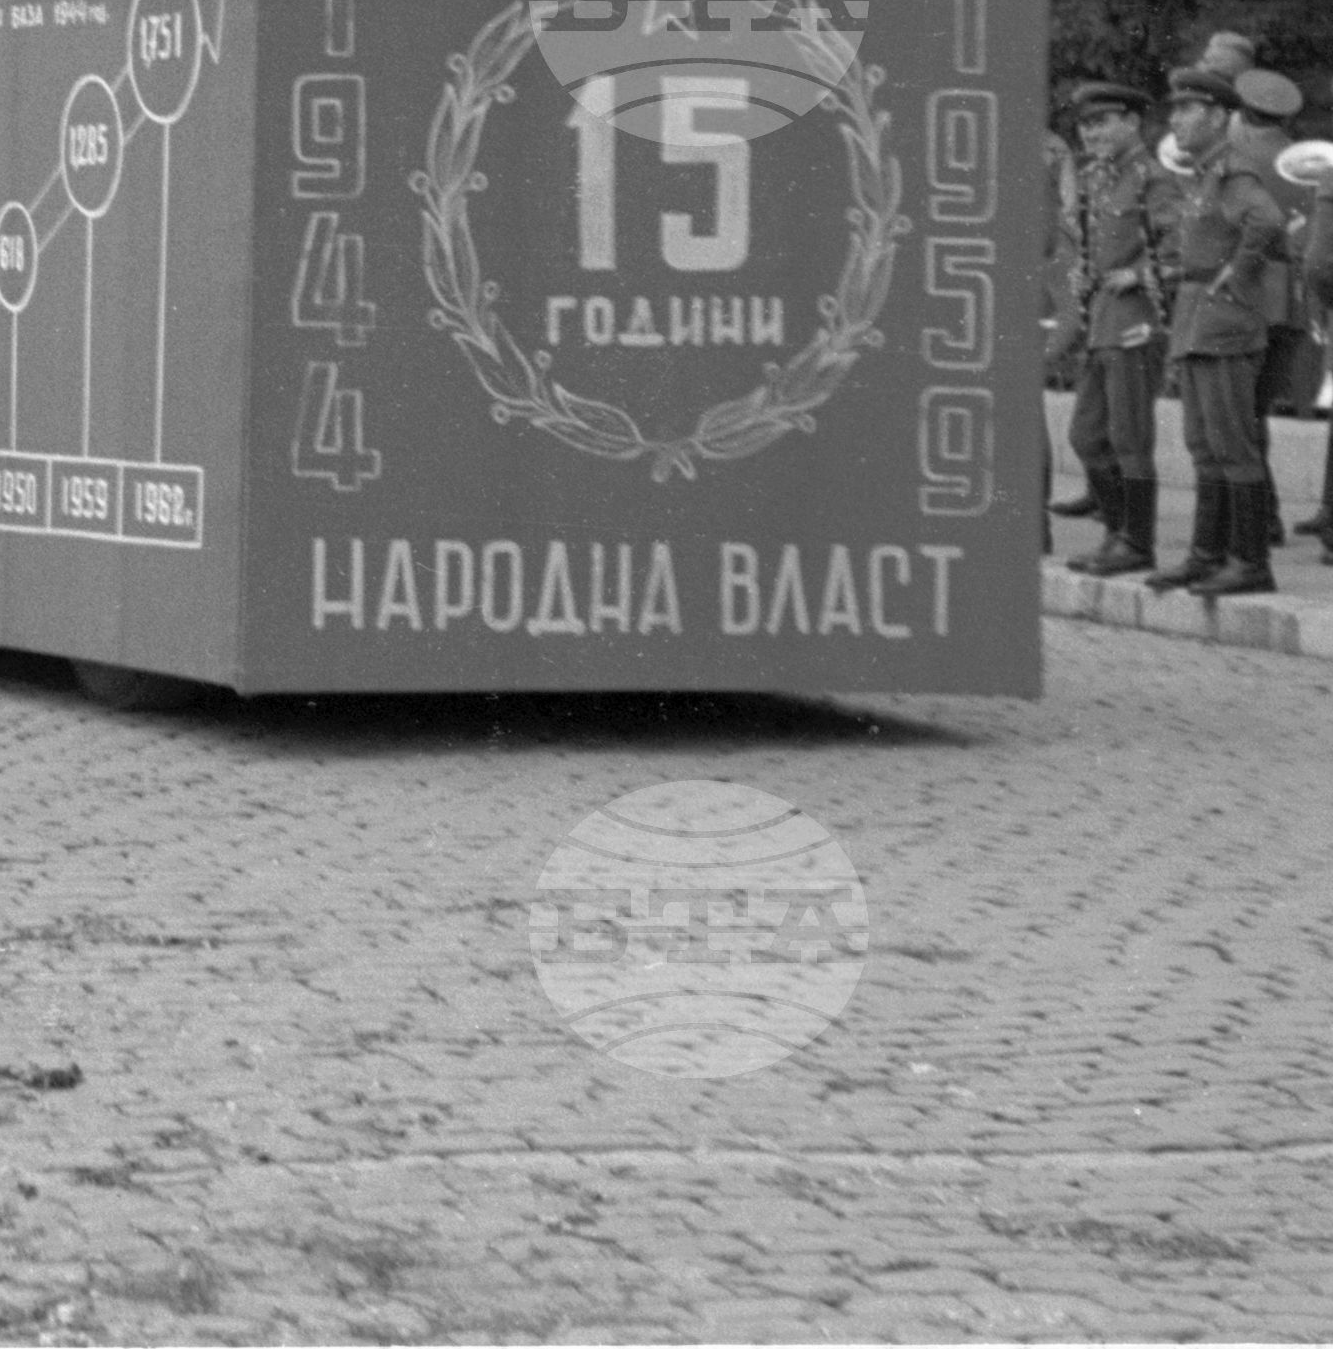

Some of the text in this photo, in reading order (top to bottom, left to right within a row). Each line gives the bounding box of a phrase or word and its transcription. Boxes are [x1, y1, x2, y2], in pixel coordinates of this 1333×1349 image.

[566, 74, 751, 272] 15
[545, 296, 785, 346] ГОДИНИ
[62, 475, 108, 521] 1959
[310, 537, 964, 638] НАРОДНА ВЛАСТ
